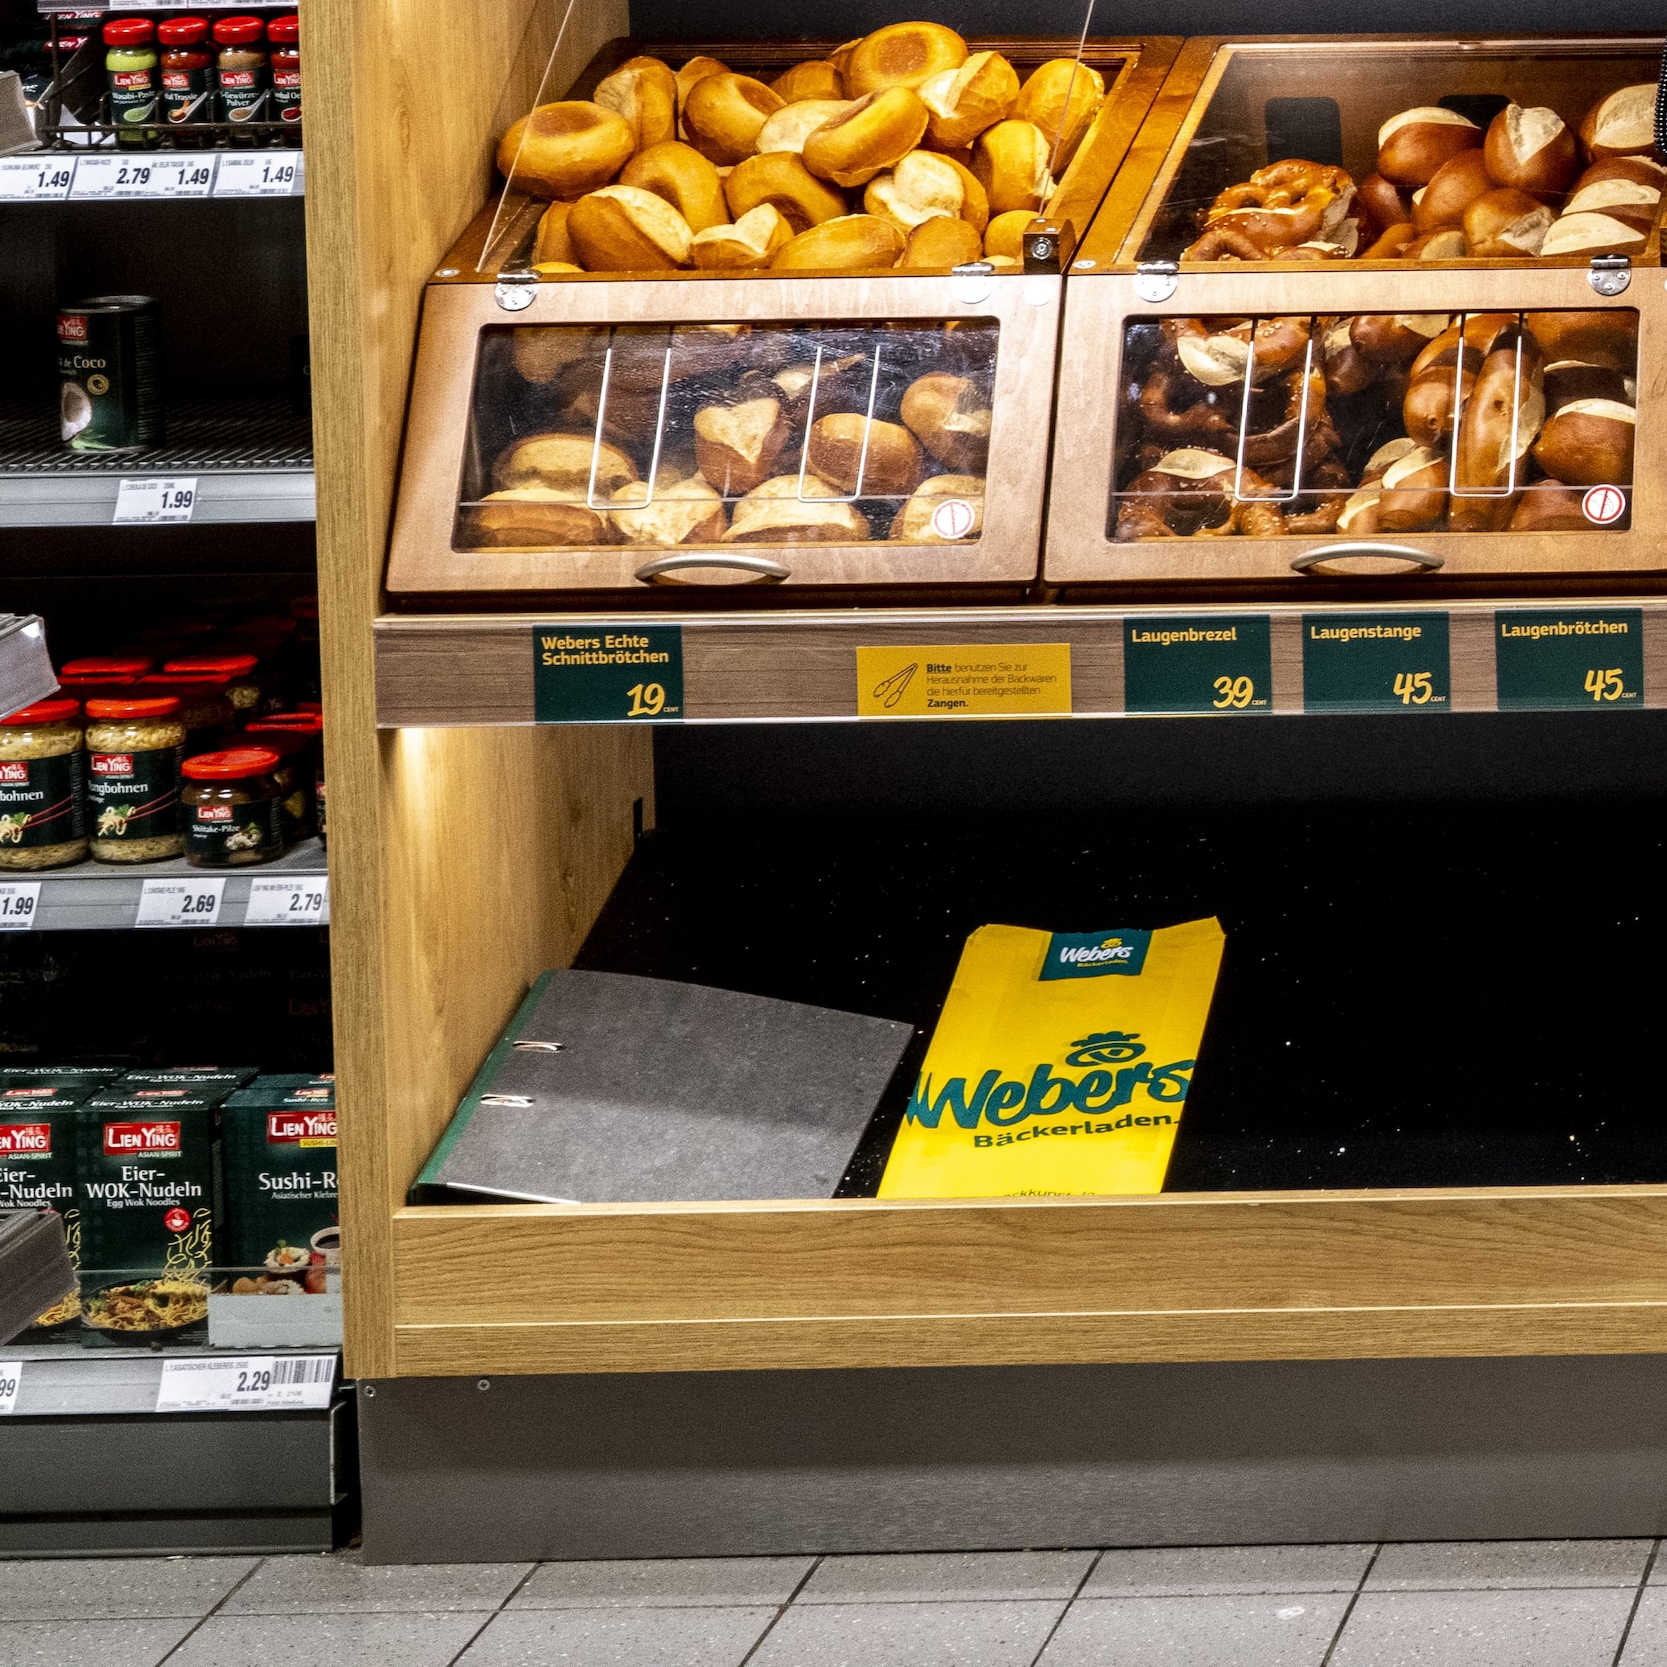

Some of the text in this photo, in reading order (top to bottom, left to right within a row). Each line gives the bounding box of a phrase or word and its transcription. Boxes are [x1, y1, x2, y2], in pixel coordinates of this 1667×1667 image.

[38, 171, 70, 188] 1.49
[117, 168, 150, 185] 2.79
[178, 169, 210, 186] 1.49
[262, 167, 294, 184] 1.49
[161, 491, 193, 509] 1.99
[1132, 627, 1237, 645] Laugenbrezel
[1311, 626, 1421, 642] Laugenstange
[1502, 620, 1628, 639] Laugenbrötchen
[541, 634, 649, 649] Webers Echte
[543, 649, 668, 665] Schnittbrötchen
[926, 663, 1028, 672] Bitte benutzen Sie zur
[926, 673, 1056, 684] Herausnahme der Backwaren
[1585, 669, 1625, 701] 45
[1213, 677, 1254, 708] 39
[1393, 672, 1433, 704] 45
[627, 683, 666, 716] 19
[927, 698, 969, 710] Zangen.
[2, 897, 34, 916] 1.99
[182, 894, 215, 913] 2.69
[289, 893, 322, 912] 2.79
[1059, 946, 1134, 963] Webers
[271, 1116, 338, 1136] LIEN YING
[108, 1128, 176, 1147] LIEN YING
[122, 1165, 165, 1181] Eier-
[85, 1181, 202, 1199] WOK-Nudeln
[107, 1197, 180, 1209] Egg Wok Noodles
[237, 1371, 271, 1392] 2.29
